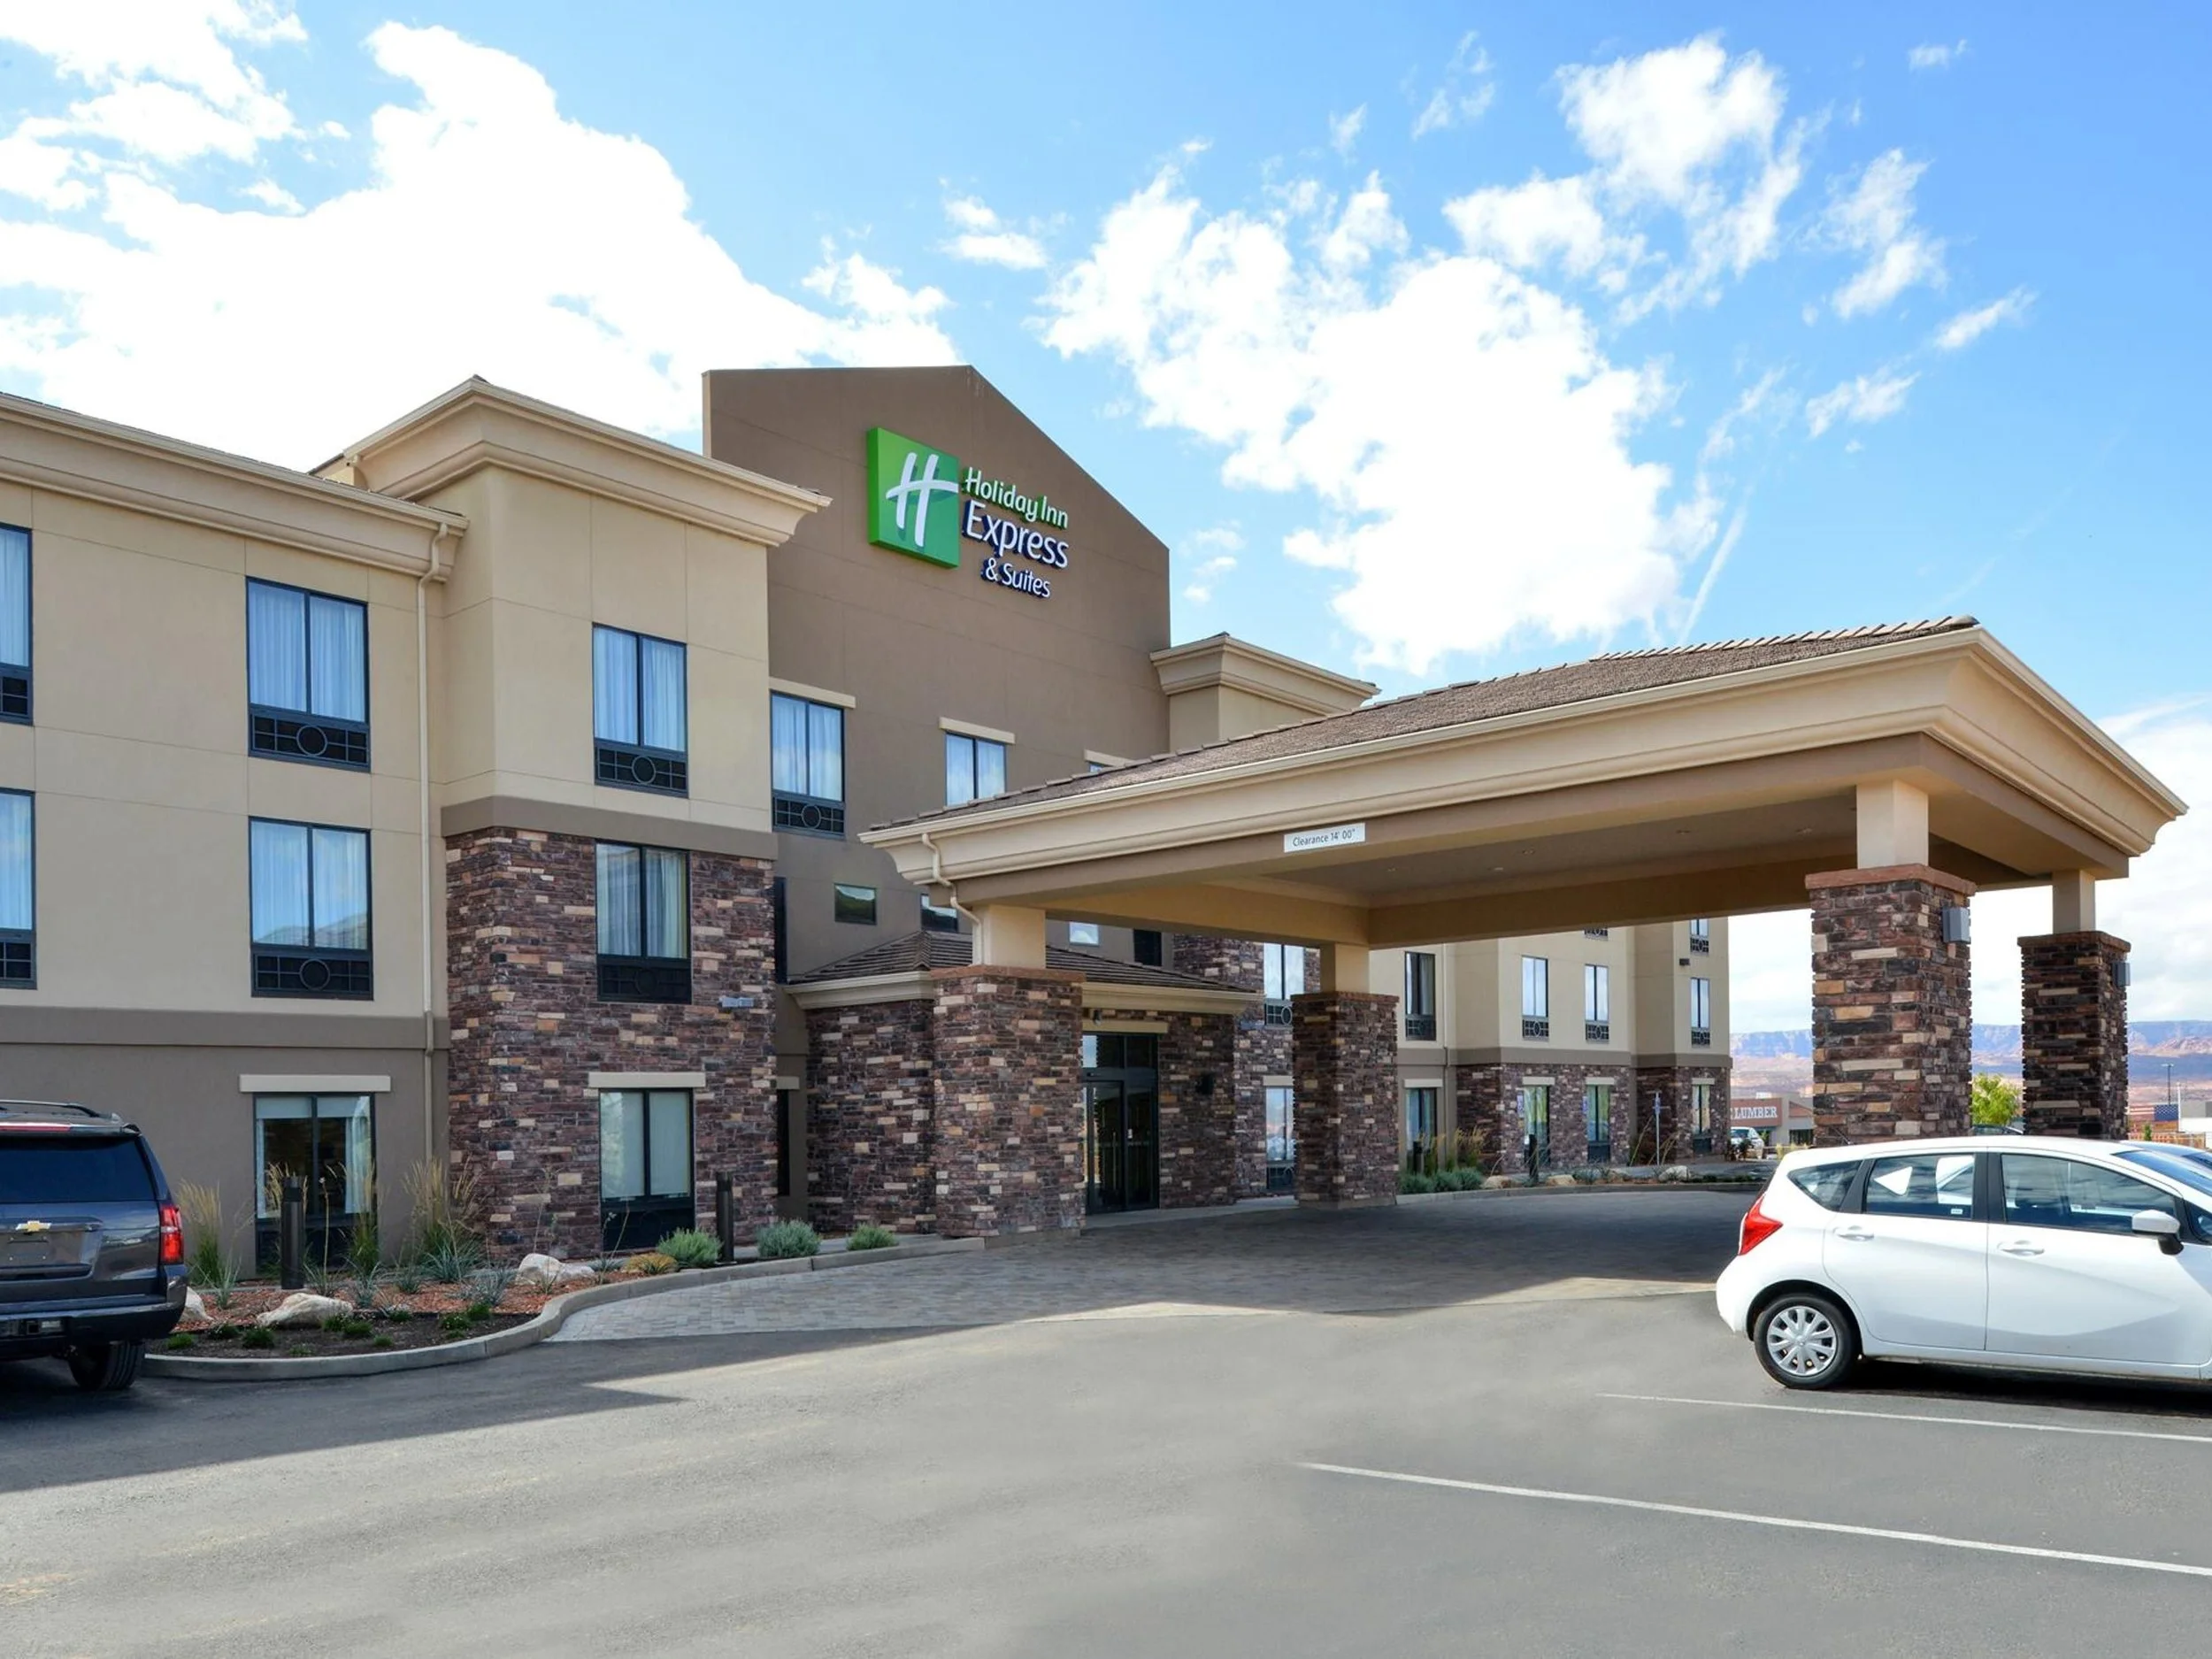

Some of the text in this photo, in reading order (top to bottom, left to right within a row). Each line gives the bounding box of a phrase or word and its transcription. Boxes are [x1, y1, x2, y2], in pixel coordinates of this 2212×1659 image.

[964, 466, 1069, 529] Holiday Inn
[964, 499, 1070, 568] Express
[984, 557, 1051, 598] & Suites
[1293, 834, 1329, 847] Clearance
[1734, 1106, 1778, 1119] LUMBER
